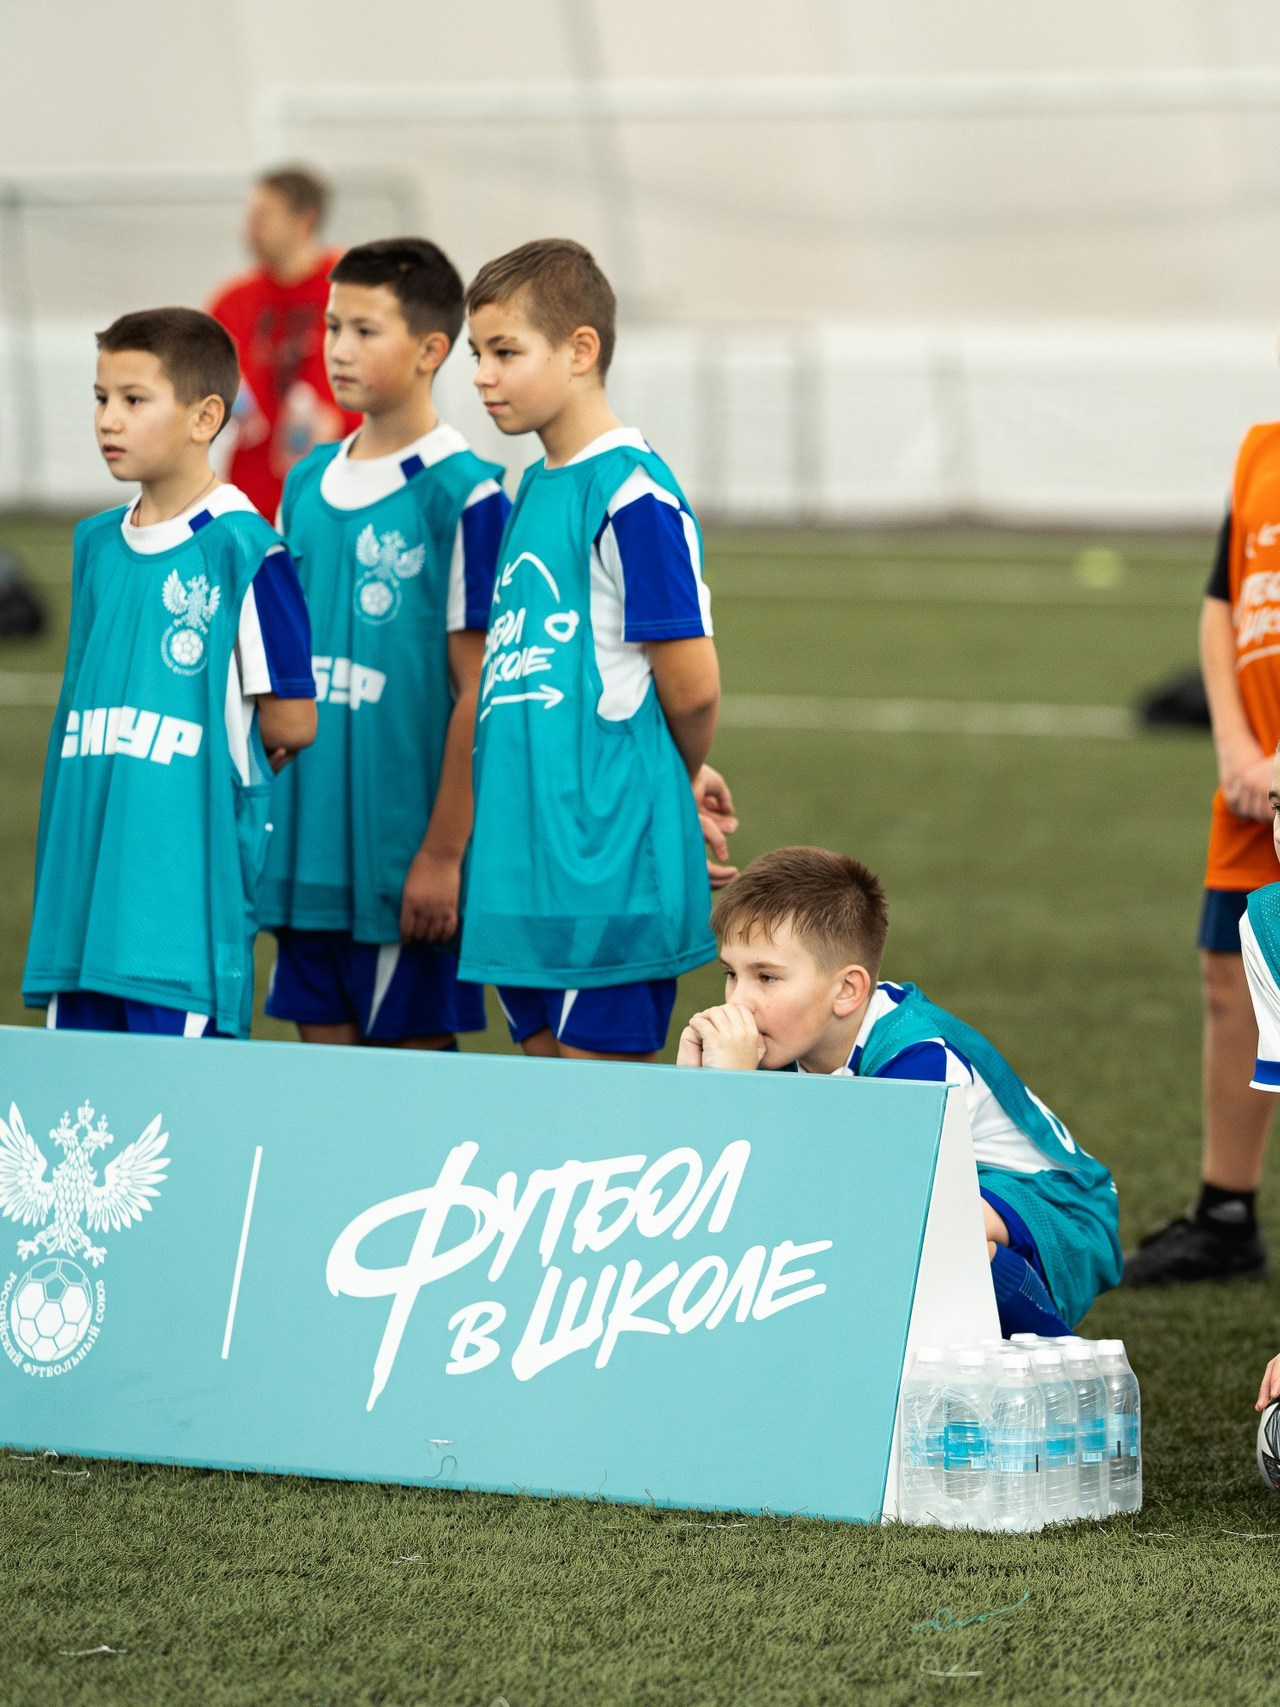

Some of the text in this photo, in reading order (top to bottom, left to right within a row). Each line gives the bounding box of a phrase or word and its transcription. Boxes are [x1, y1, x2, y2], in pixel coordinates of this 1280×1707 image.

[23, 1324, 101, 1378] ФУТБОЛЬНЫЙ
[95, 1279, 106, 1323] СОЮЗ
[326, 1140, 751, 1412] ФУТБОЛ
[511, 1239, 833, 1382] ШКОЛЕ
